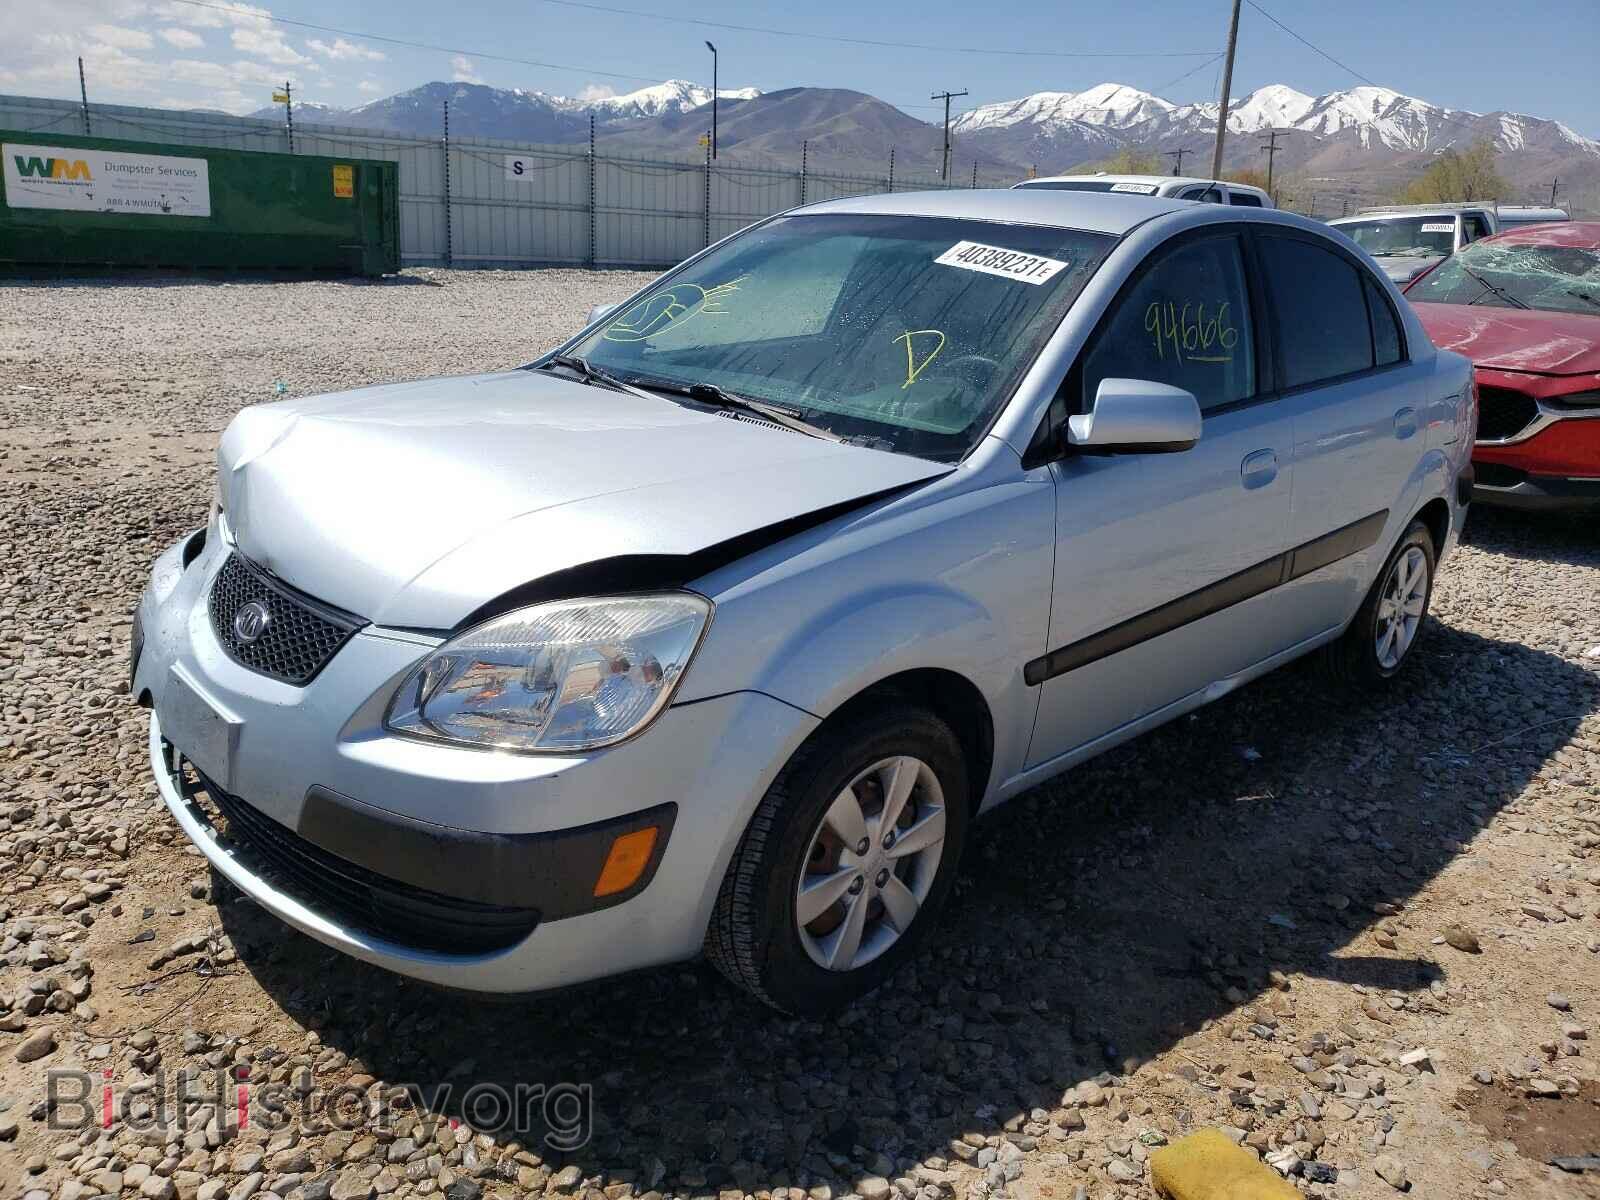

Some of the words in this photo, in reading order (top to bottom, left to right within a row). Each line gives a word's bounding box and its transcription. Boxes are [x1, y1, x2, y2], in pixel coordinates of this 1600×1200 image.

[14, 155, 92, 181] WM
[105, 161, 154, 175] Dumpster
[159, 166, 198, 177] Services
[513, 160, 524, 175] S
[957, 246, 1048, 276] 40389231
[1144, 302, 1238, 367] 94666
[892, 330, 945, 389] D
